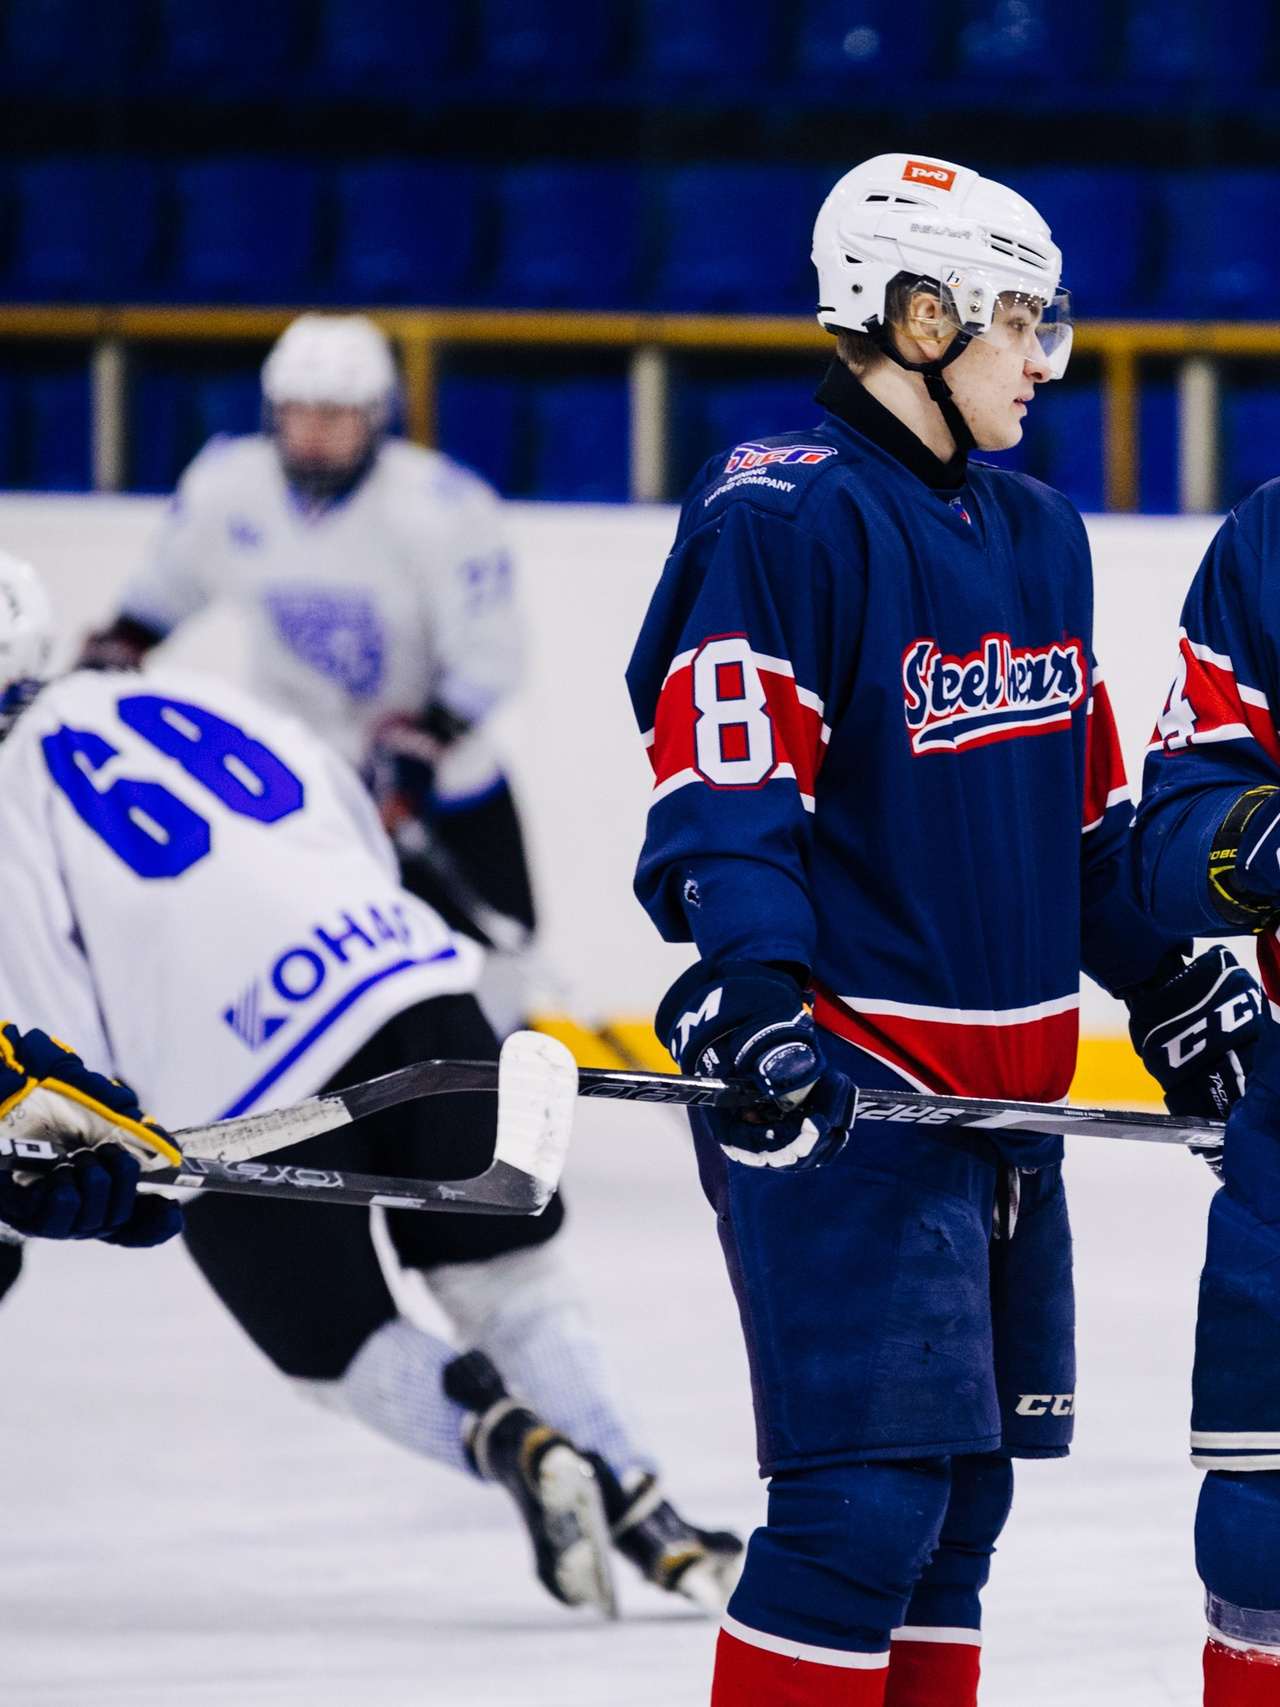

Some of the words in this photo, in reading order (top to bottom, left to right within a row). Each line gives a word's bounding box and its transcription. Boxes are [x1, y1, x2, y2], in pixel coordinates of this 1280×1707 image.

[736, 476, 796, 492] COMPANY
[691, 633, 778, 790] 8
[41, 694, 304, 879] 68
[1015, 1394, 1075, 1417] CC
